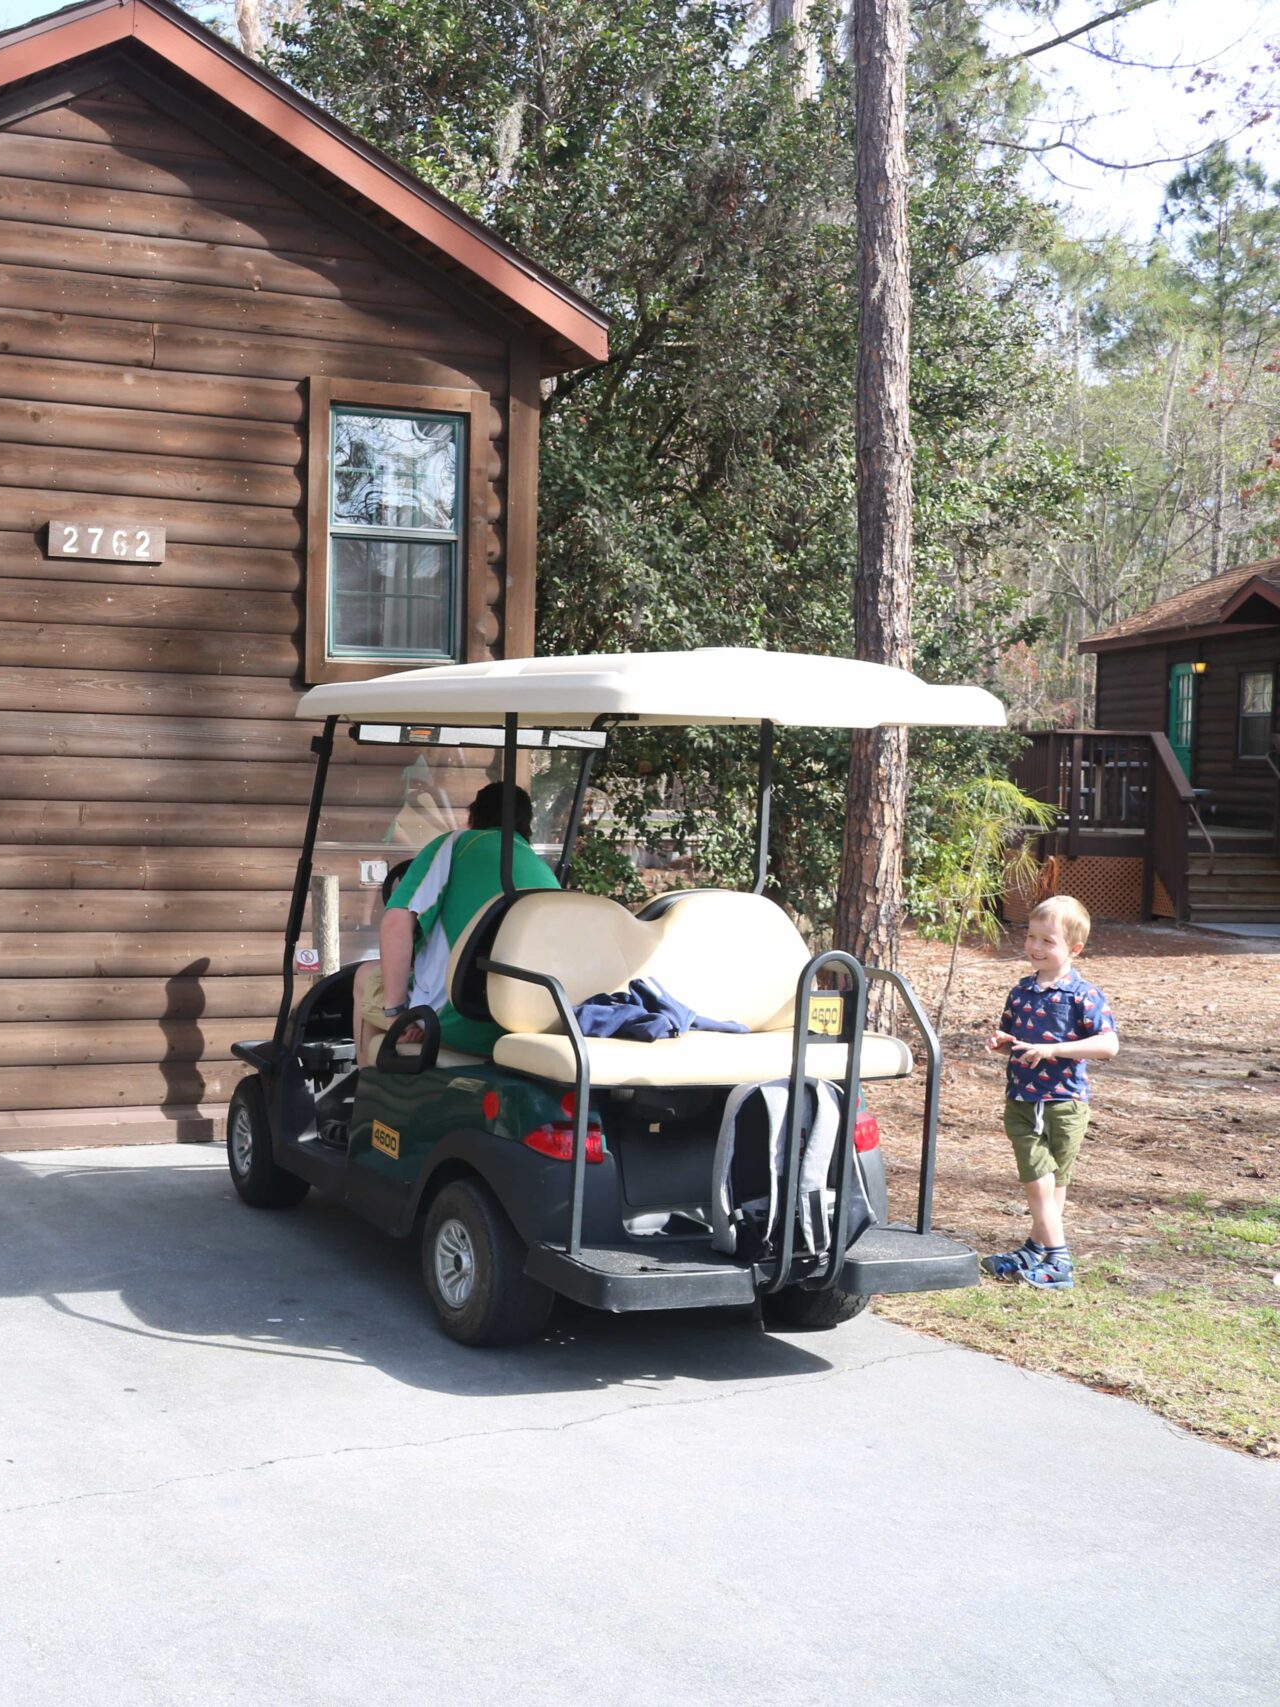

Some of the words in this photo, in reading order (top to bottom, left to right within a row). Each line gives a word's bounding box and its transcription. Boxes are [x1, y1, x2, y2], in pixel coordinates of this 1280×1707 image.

[62, 526, 150, 557] 2762
[811, 1007, 837, 1025] 4600
[374, 1128, 398, 1151] 4600
